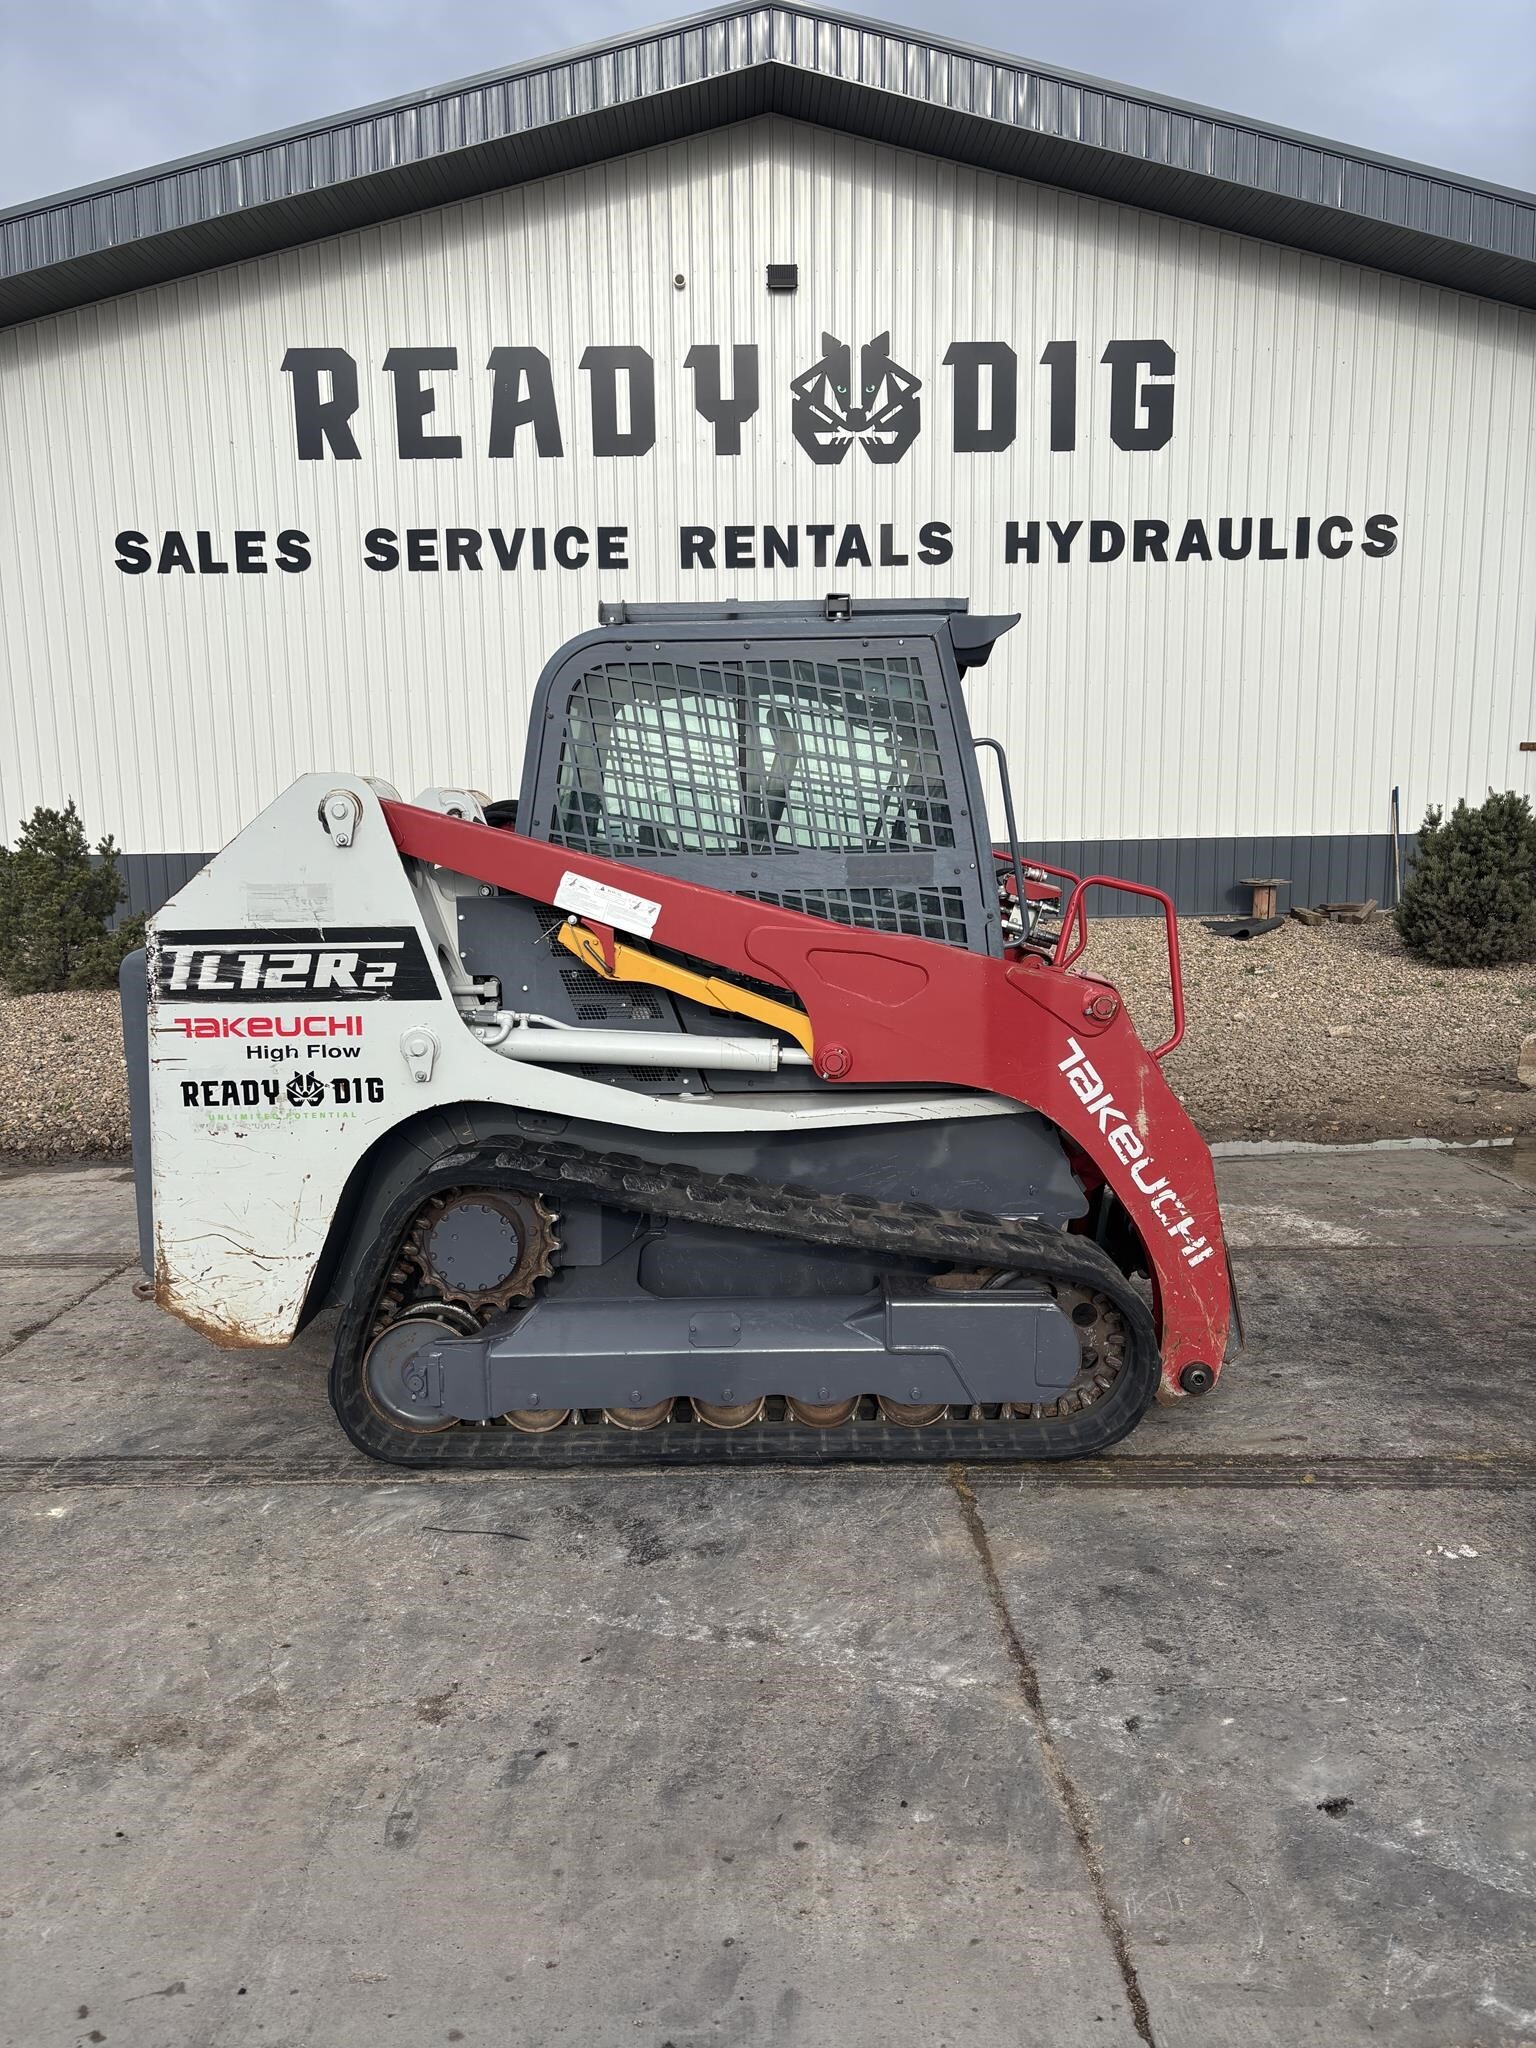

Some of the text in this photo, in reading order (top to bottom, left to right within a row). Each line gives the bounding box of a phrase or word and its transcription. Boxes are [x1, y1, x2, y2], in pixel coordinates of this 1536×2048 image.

[280, 340, 1176, 461] READY DIG
[114, 514, 1399, 575] SALES SERVICE RENTALS HYDRAULICS
[246, 1044, 361, 1062] High Flow
[180, 1077, 385, 1107] READY DIG
[208, 1111, 357, 1122] UNLIMITED POTENTIAL
